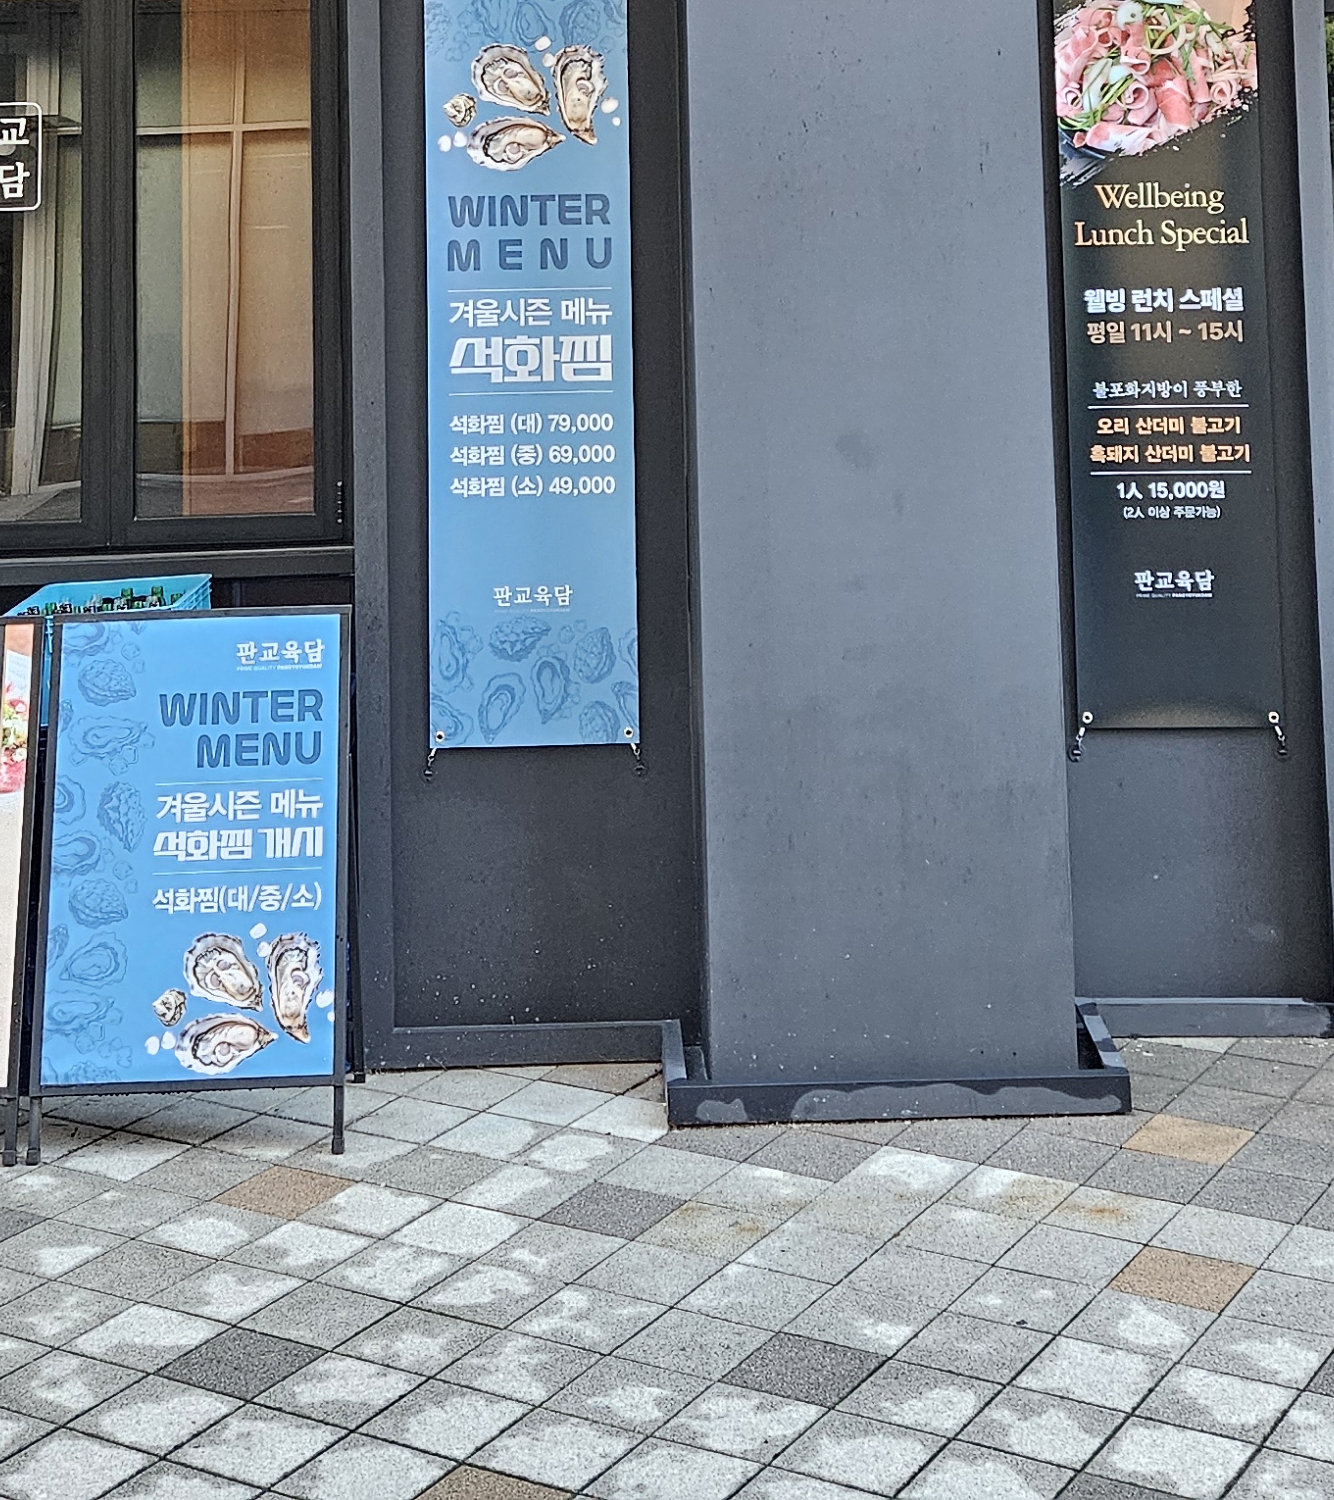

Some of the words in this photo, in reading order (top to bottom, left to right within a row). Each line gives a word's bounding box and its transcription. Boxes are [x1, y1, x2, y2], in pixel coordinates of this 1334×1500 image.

[448, 194, 610, 228] WINTER
[1094, 182, 1225, 214] Wellbeing
[1074, 220, 1154, 246] Lunch
[1161, 218, 1249, 251] Special
[448, 237, 612, 272] MENU
[449, 298, 552, 328] 겨울시즌
[561, 297, 612, 326] 메뉴
[1084, 288, 1125, 313] 웰빙
[1131, 287, 1174, 313] 런치
[1179, 287, 1244, 312] 스페셜
[1087, 322, 1125, 344] 평일
[1131, 320, 1172, 343] 11시
[1198, 320, 1244, 342] 15시
[449, 334, 613, 383] 석화찜
[1193, 380, 1242, 398] 풍부한
[449, 414, 504, 435] 석화찜
[511, 413, 542, 434] (대)
[548, 413, 613, 433] 79,000
[1097, 417, 1130, 435] 오리
[1136, 416, 1185, 434] 산더미
[1191, 416, 1241, 434] 불고기
[450, 445, 504, 466] 석화찜
[511, 444, 543, 465] (중)
[548, 444, 615, 465] 69,000
[1090, 445, 1139, 463] 흑돼지
[1145, 444, 1193, 462] 산더미
[1199, 444, 1250, 462] 불고기
[450, 476, 504, 498] 석화찜
[511, 475, 543, 496] (소)
[549, 475, 615, 496] 49,000
[1148, 480, 1226, 500] 15,000원
[1148, 506, 1170, 519] 이상
[1174, 505, 1221, 519] 주문가능)
[1134, 569, 1214, 591] 판교육담
[493, 584, 573, 606] 판교육담
[236, 639, 325, 665] 판교육담
[159, 689, 323, 727] WINTER
[197, 731, 321, 768] MENU
[156, 790, 262, 823] 겨울시즌
[271, 788, 323, 819] 메뉴
[153, 828, 253, 862] 석화찜
[258, 826, 323, 859] 개시
[152, 882, 322, 914] 석화찜(대/중/소)
